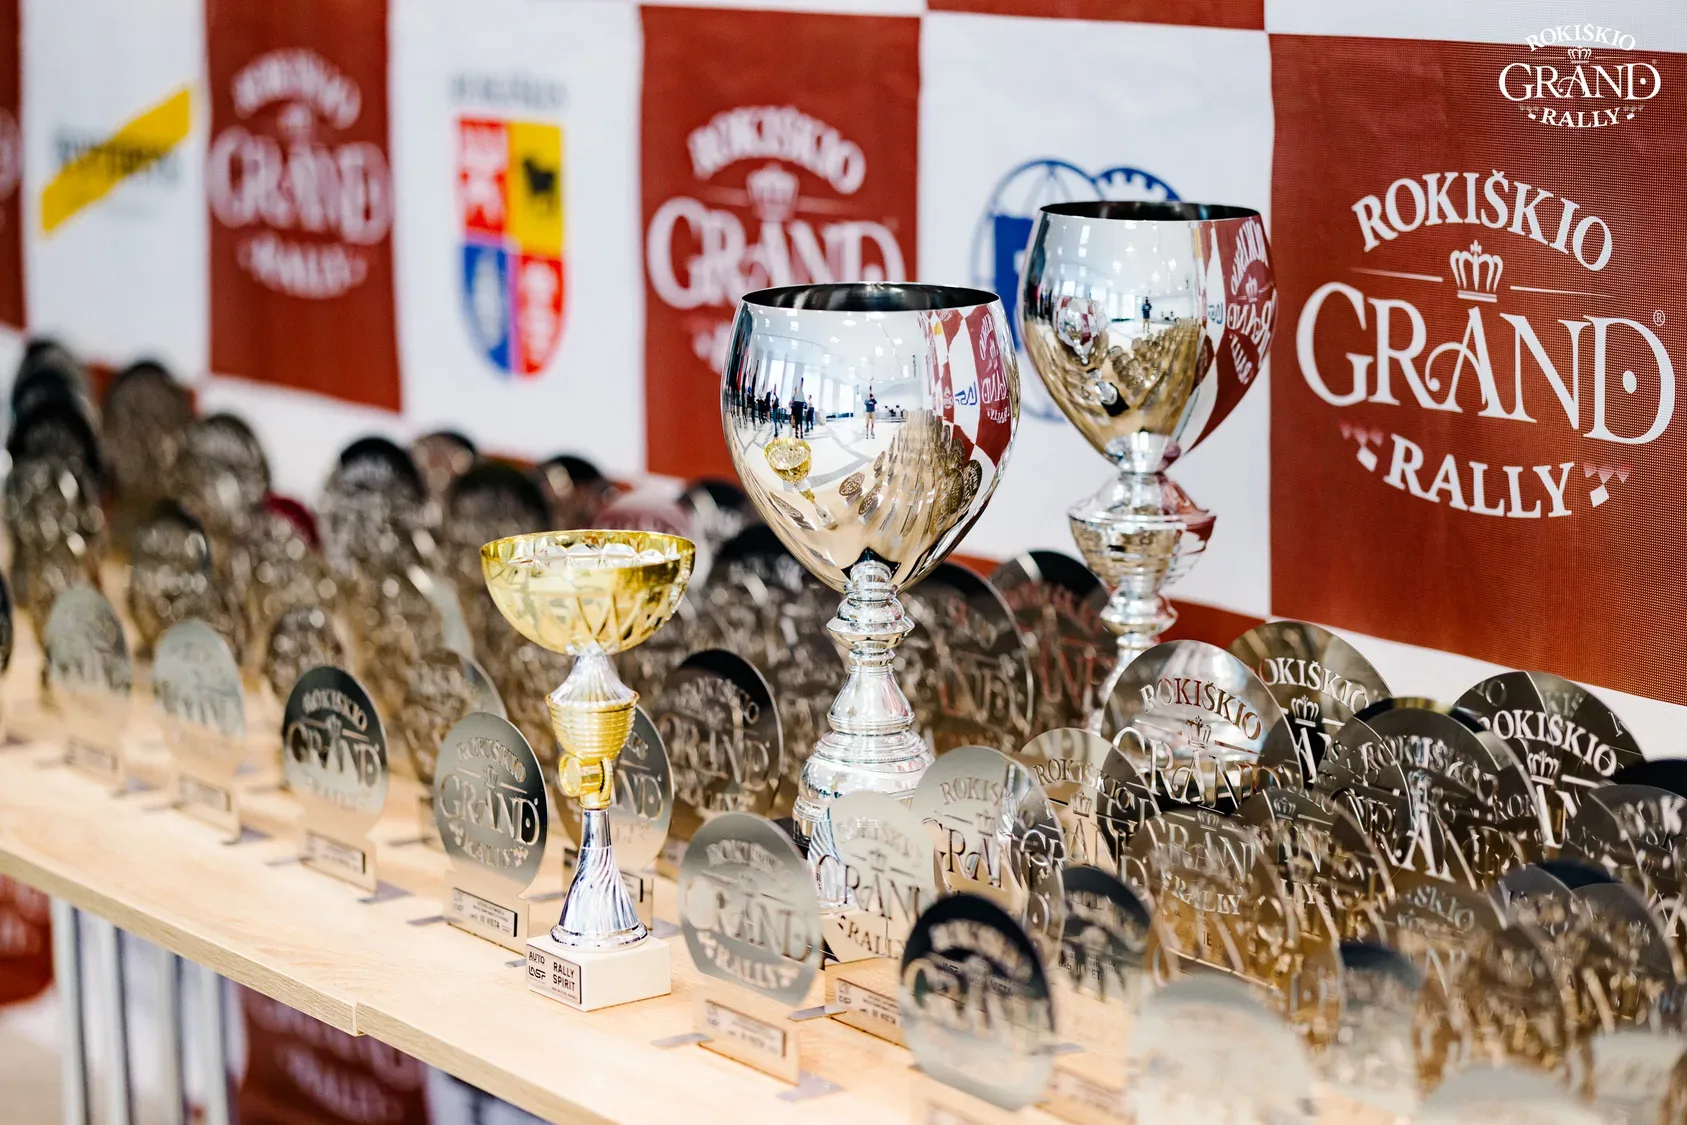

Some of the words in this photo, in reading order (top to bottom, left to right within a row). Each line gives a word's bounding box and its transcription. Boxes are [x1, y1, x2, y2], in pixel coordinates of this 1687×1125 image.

[1351, 169, 1613, 272] ROKIŠKIO
[1296, 281, 1676, 445] GRAND
[1383, 433, 1575, 519] RALLY
[1140, 677, 1262, 741] ROKIŠKIO
[1249, 657, 1370, 714] OKIŠKIO
[528, 951, 545, 965] AUTO
[552, 974, 576, 991] SPIRIT
[553, 962, 575, 979] RALLY
